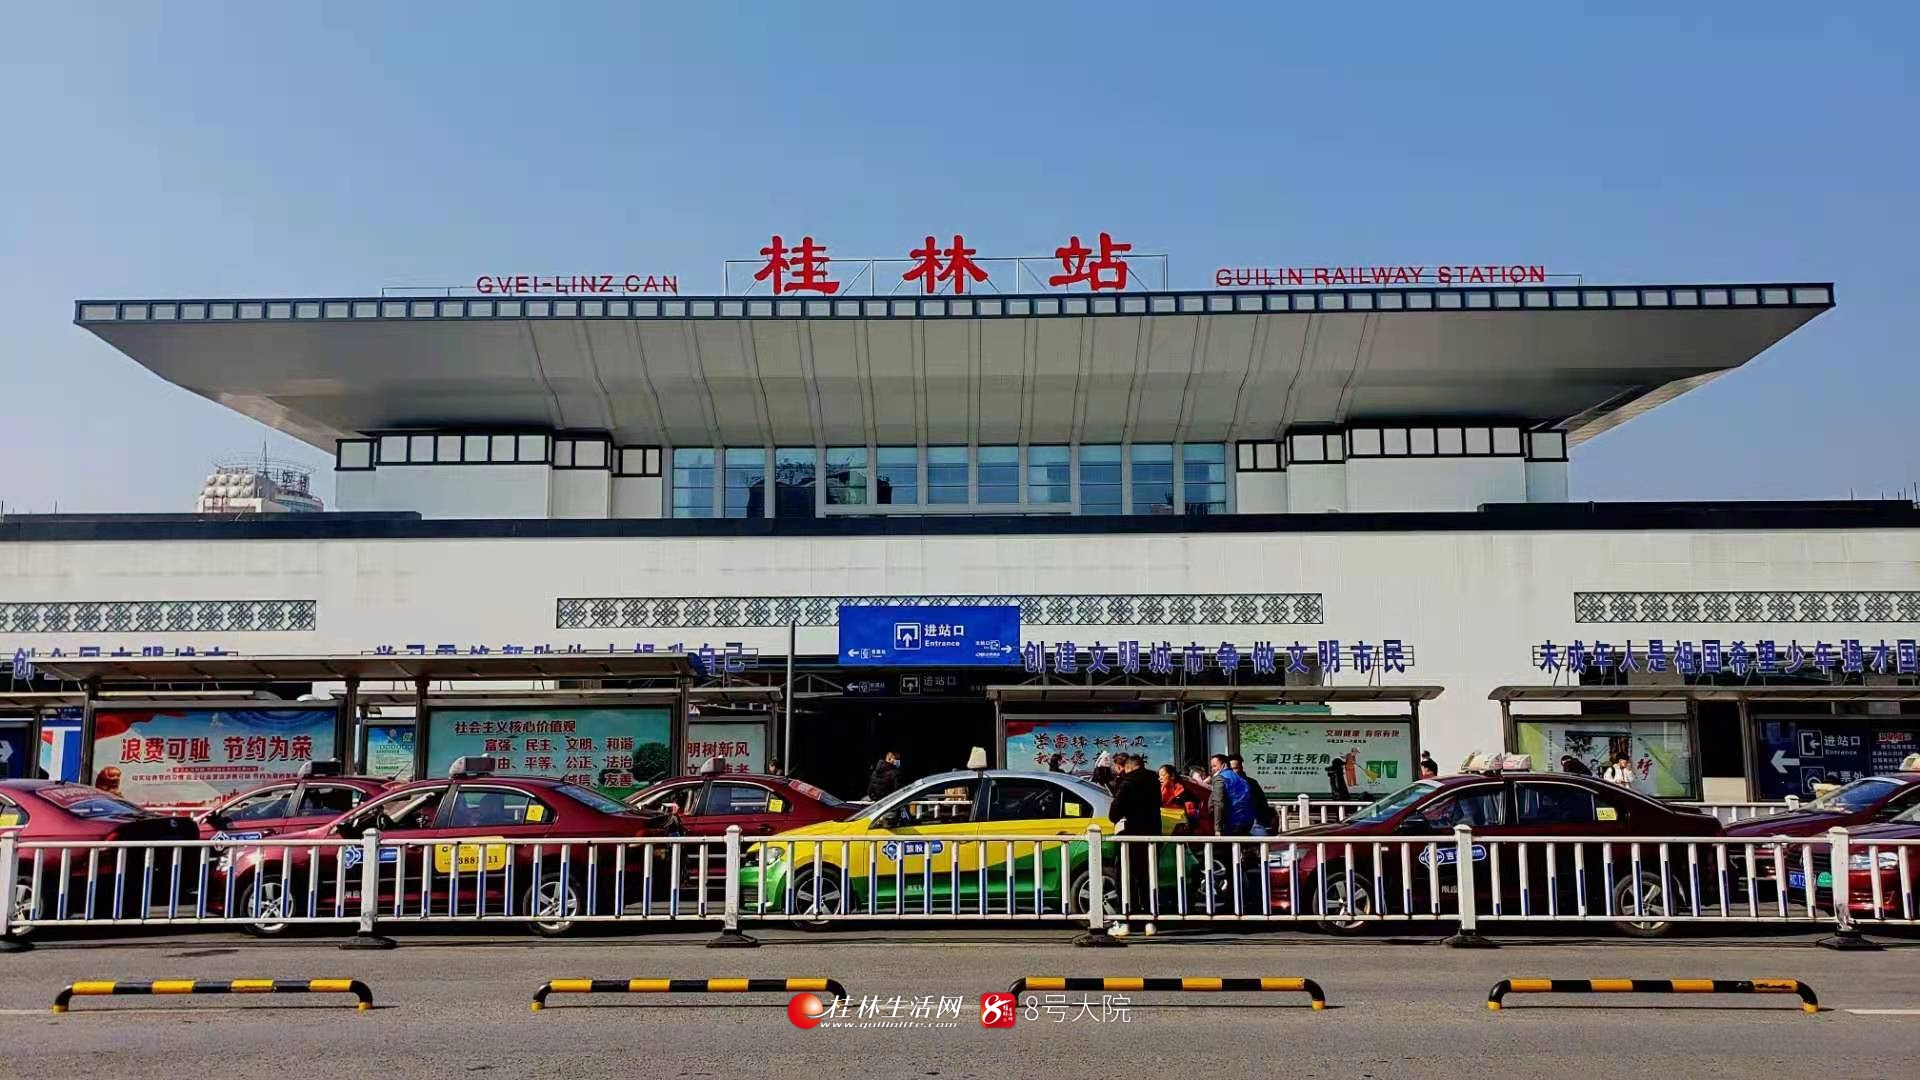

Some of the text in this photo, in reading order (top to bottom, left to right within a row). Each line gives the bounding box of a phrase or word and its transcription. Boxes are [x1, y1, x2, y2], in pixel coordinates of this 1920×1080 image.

[754, 233, 1131, 296] 桂林站
[1216, 265, 1545, 286] GUILIN RAILWAY STATION
[476, 275, 678, 293] GVEI-LINZ CAN
[924, 623, 965, 637] 进站口
[1022, 639, 1406, 674] 创建文明城市争做文明市民
[455, 720, 577, 734] 社会主义核心价值观
[485, 737, 634, 751] 富强、民主、文明、和谐
[1824, 735, 1861, 747] 进站口
[120, 736, 313, 763] 浪费可耻 节约为荣
[1252, 753, 1331, 764] 不留卫生死角
